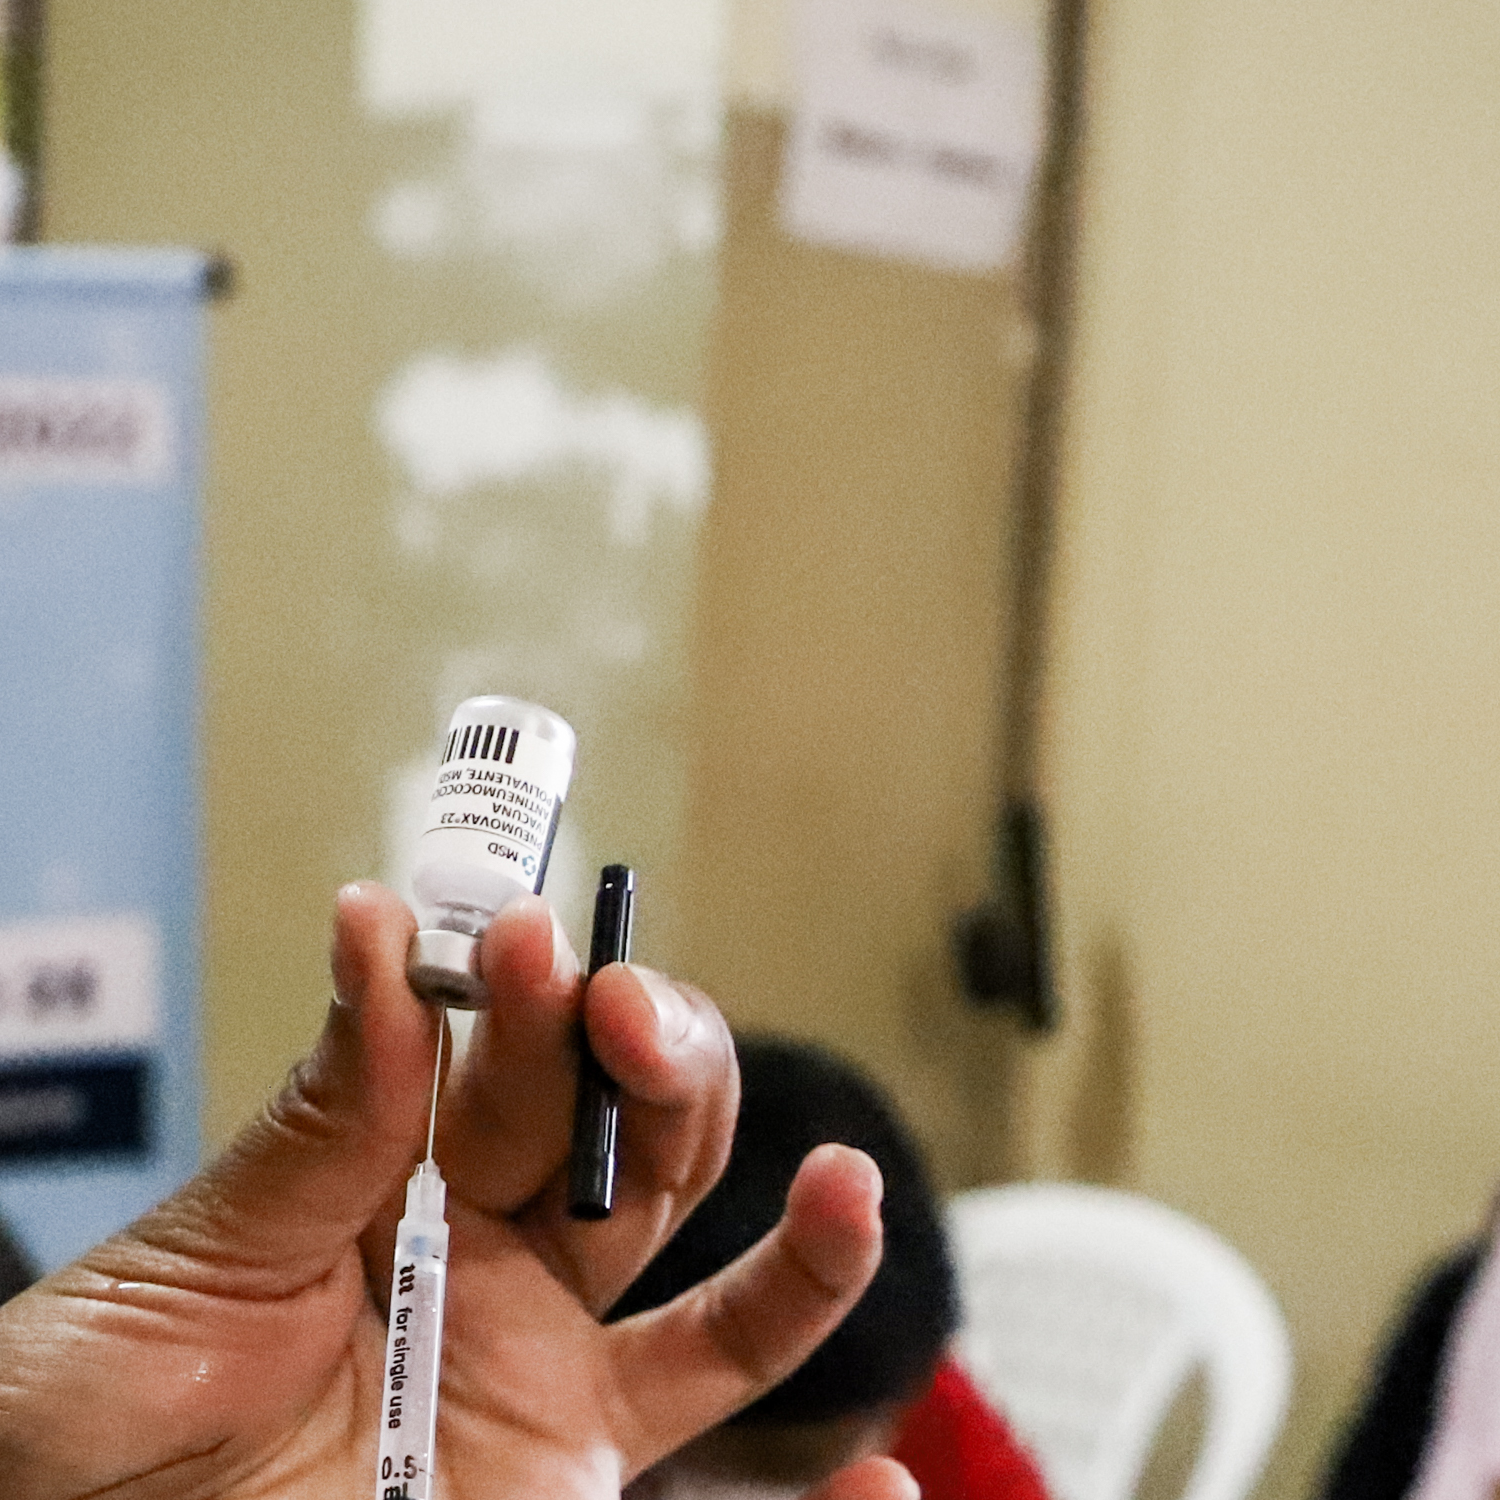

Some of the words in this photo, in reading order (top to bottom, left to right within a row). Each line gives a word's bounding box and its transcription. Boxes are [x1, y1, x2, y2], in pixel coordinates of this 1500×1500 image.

[488, 842, 518, 862] MSD
[396, 1306, 413, 1332] for
[389, 1337, 411, 1391] single
[388, 1396, 402, 1429] use
[382, 1454, 417, 1480] 0.5
